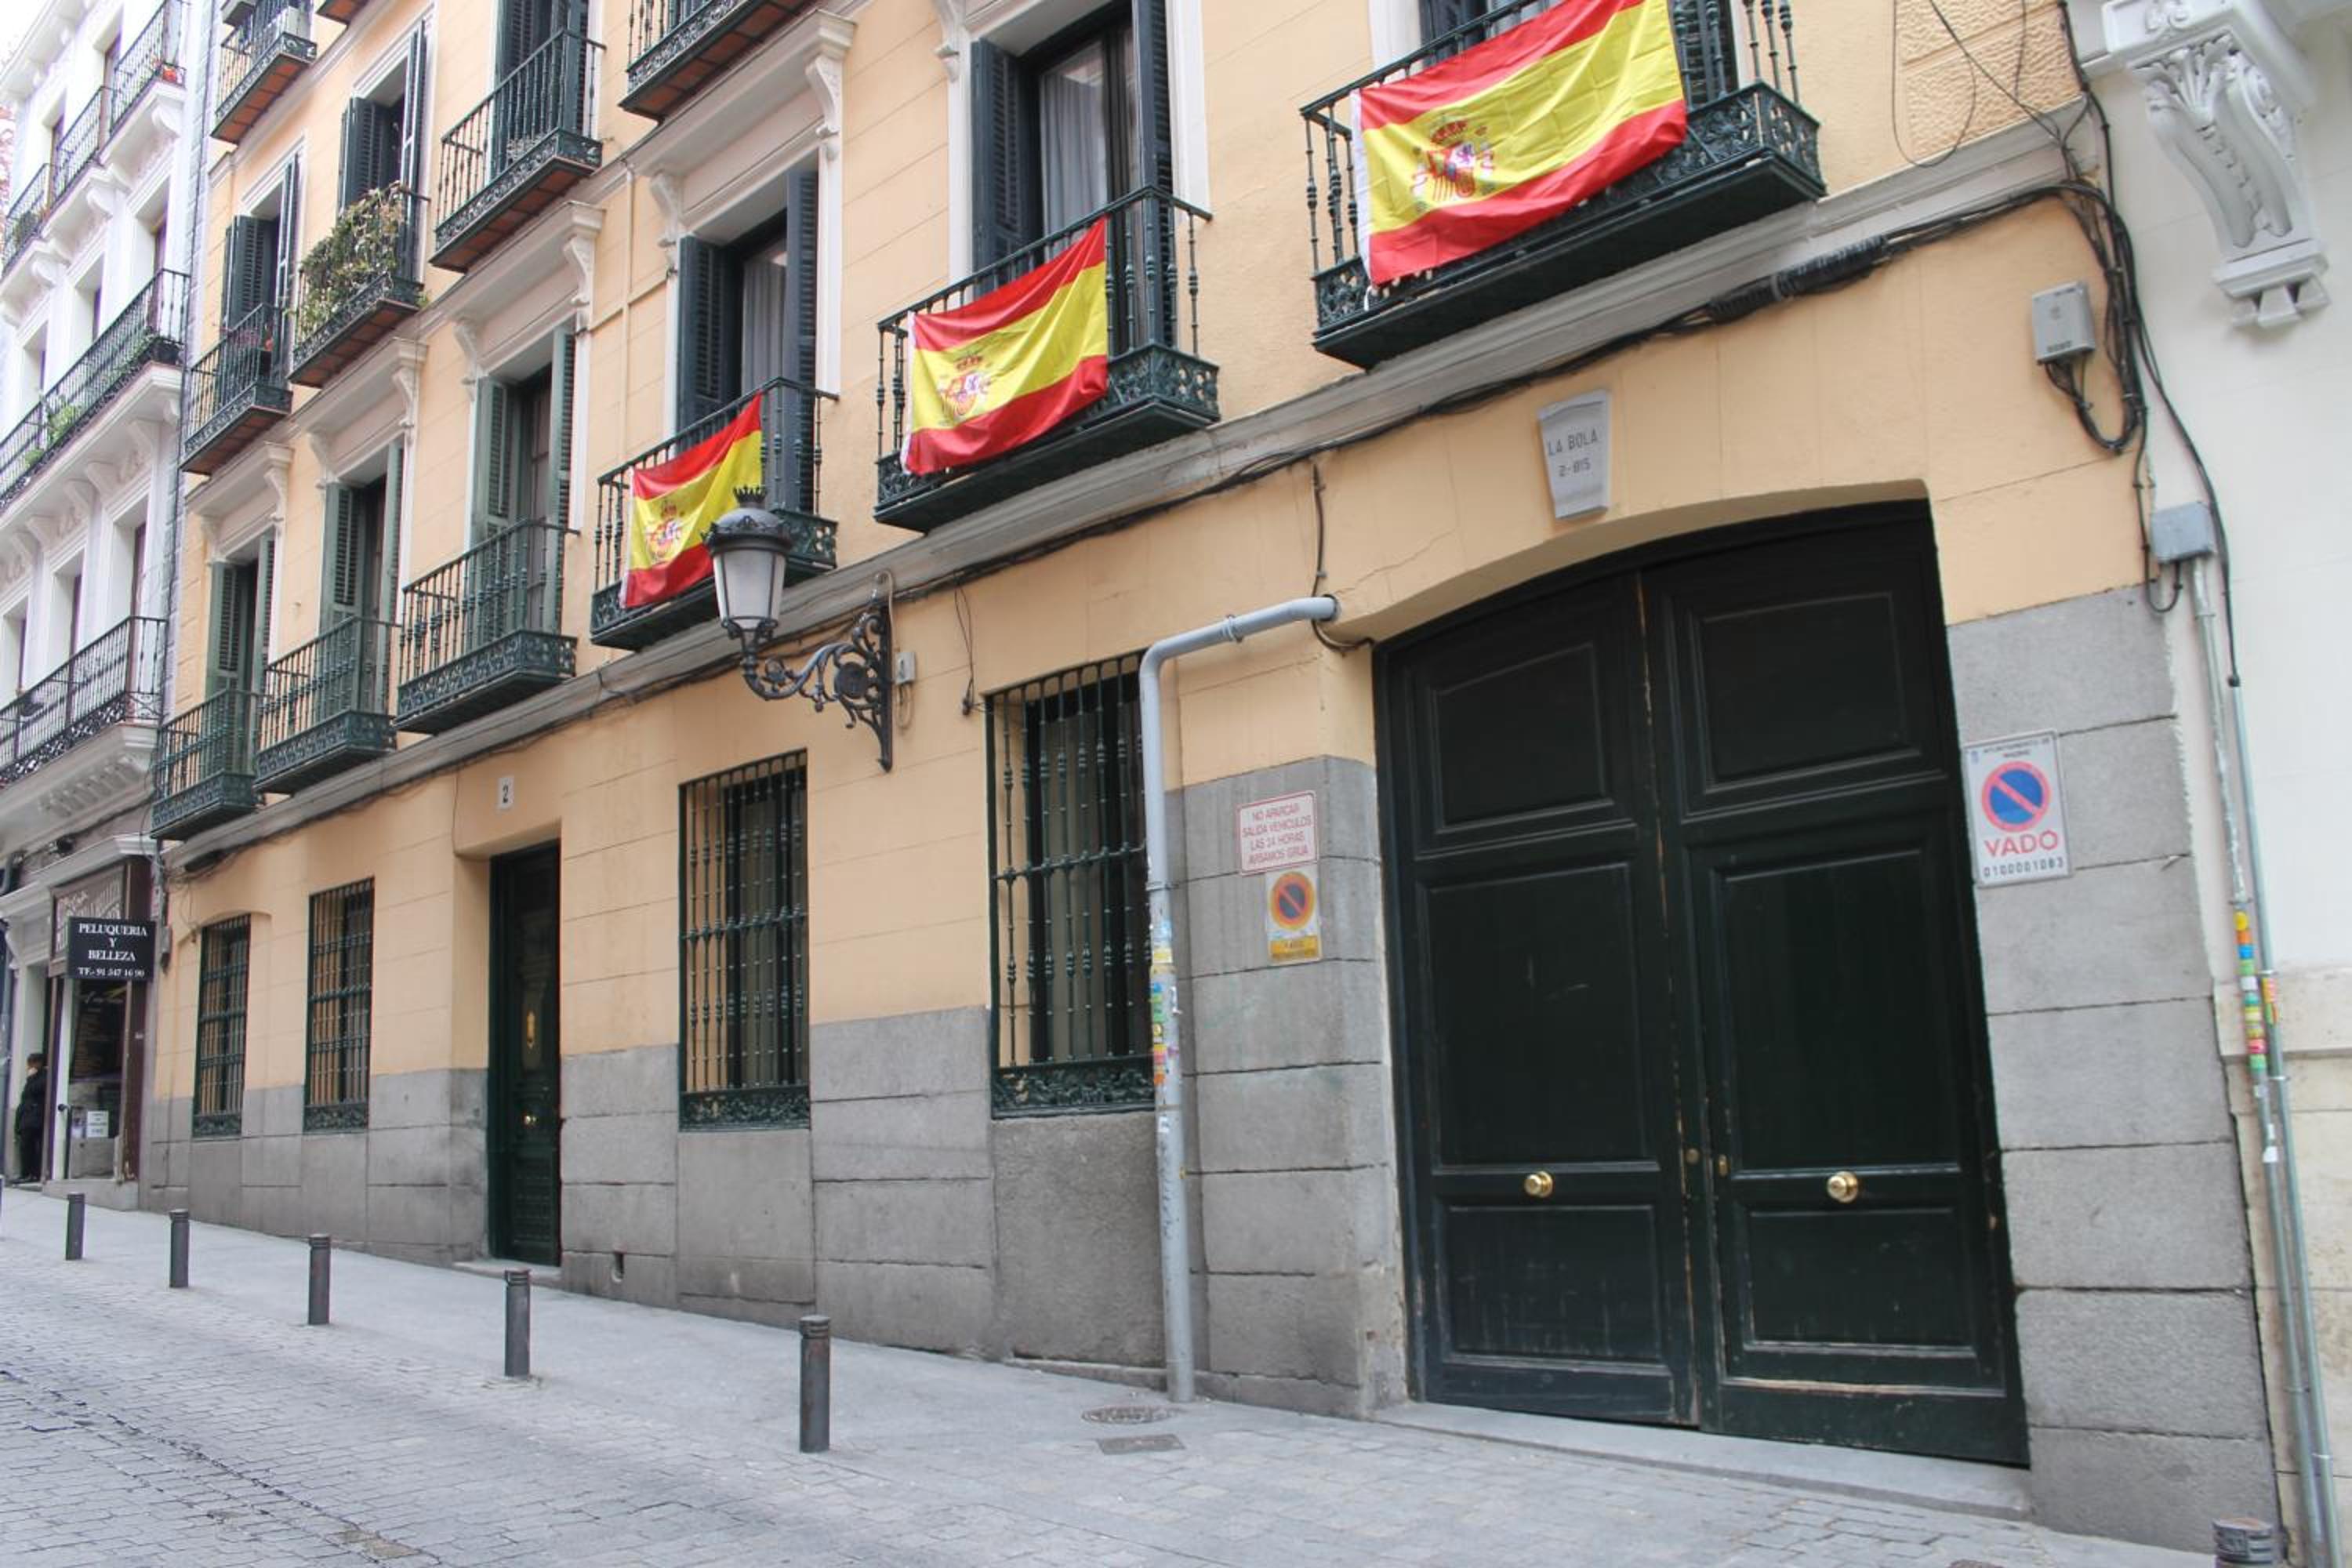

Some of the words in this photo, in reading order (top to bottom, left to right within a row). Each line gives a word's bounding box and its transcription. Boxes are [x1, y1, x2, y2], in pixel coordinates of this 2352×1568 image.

[1548, 439, 1563, 456] LA
[1568, 429, 1598, 451] BOLA
[1252, 809, 1263, 821] NO
[1265, 803, 1300, 819] APARCAR
[1242, 825, 1268, 838] SALIDA
[1269, 815, 1312, 833] VEHICULOS
[1250, 838, 1265, 851] LAS
[1278, 830, 1305, 845] HORAS
[1984, 829, 2058, 858] VADO
[78, 923, 147, 936] PELUQUERIA
[109, 937, 117, 948] Y
[88, 949, 136, 962] BELLEZA
